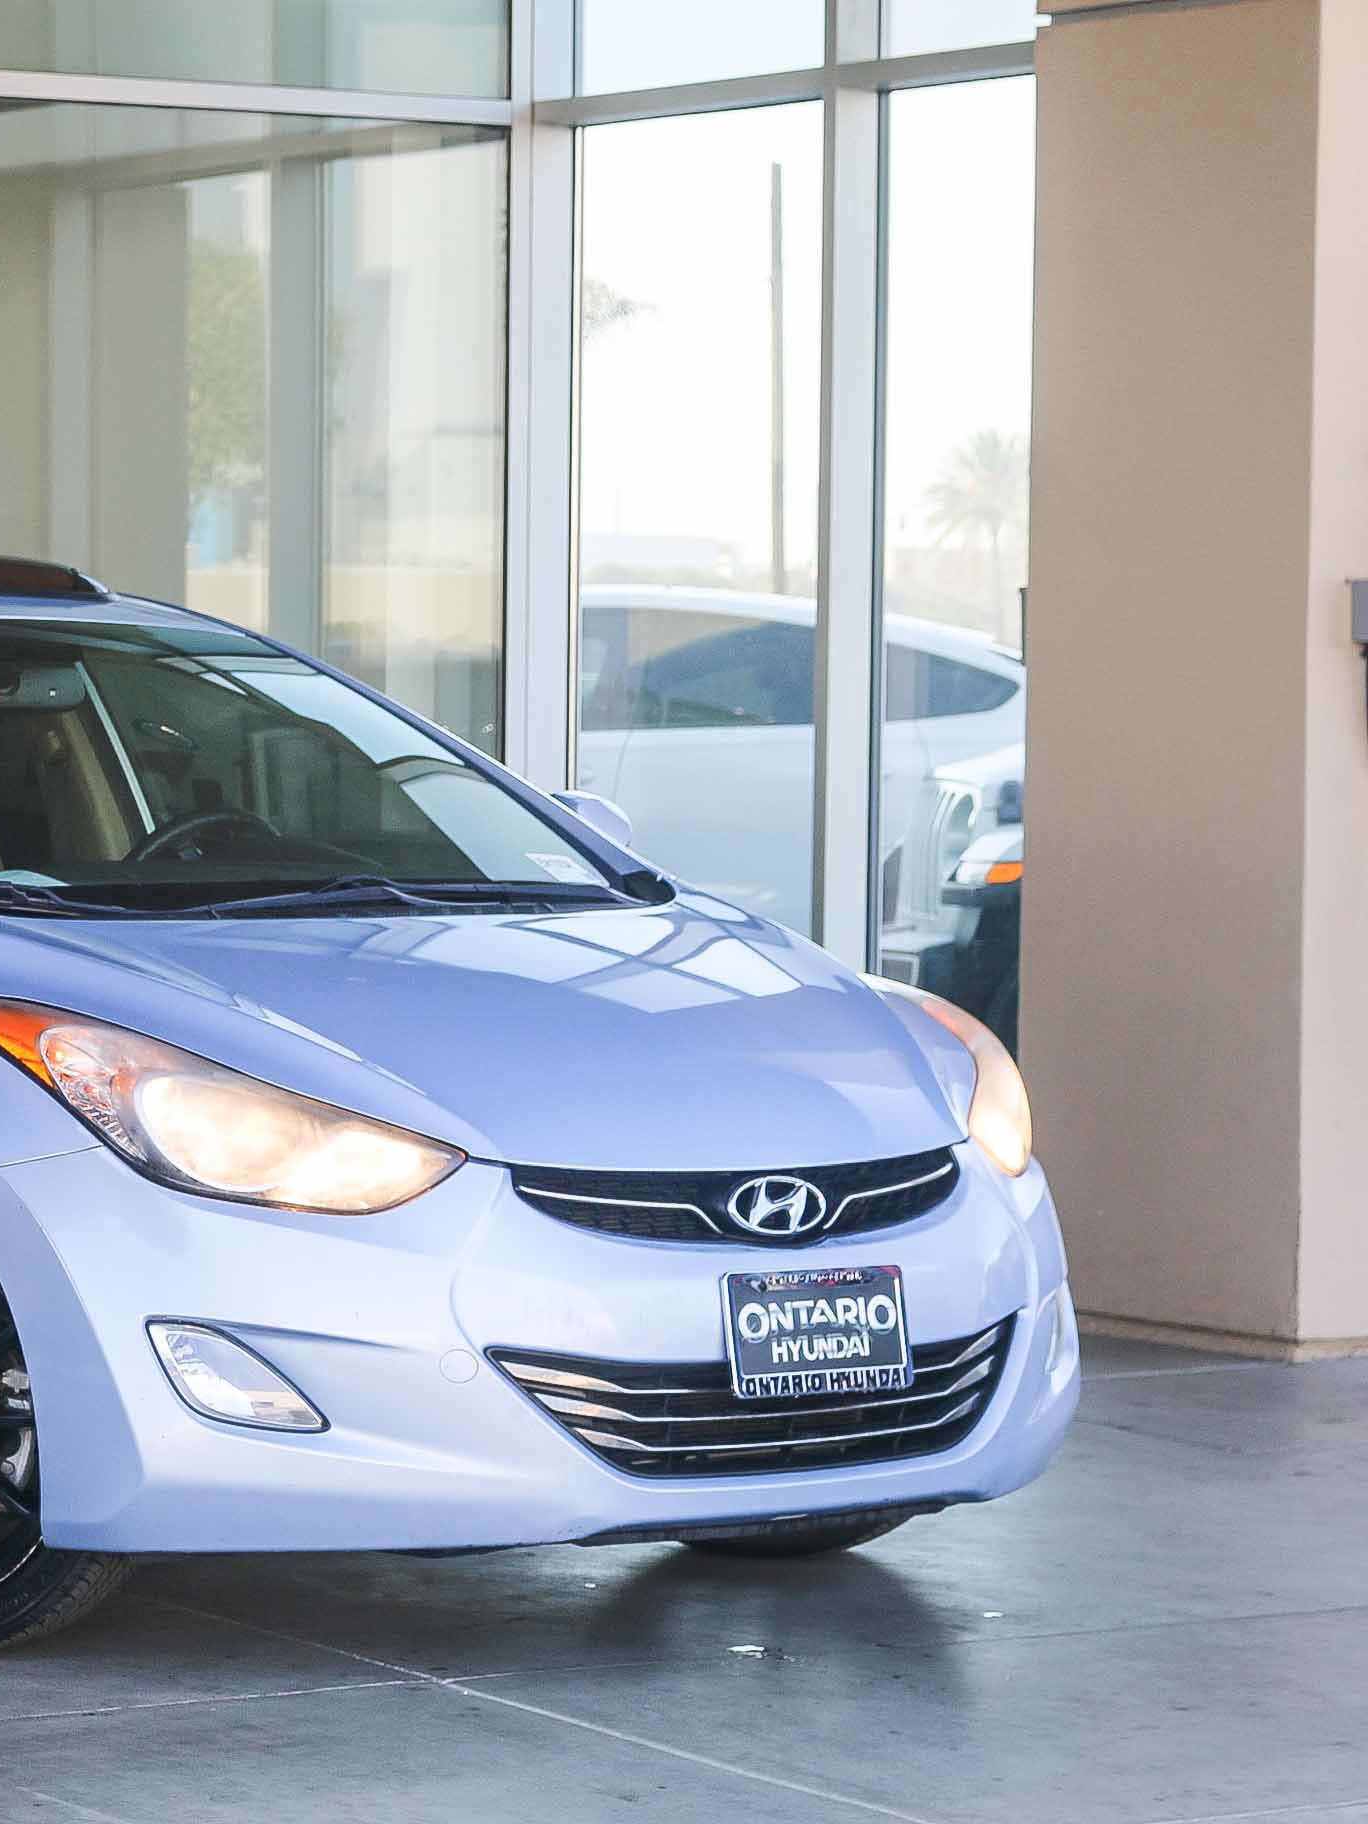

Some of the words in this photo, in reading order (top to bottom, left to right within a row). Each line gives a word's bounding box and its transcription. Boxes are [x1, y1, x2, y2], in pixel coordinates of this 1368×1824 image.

[738, 1294, 897, 1341] ONTARIO
[771, 1332, 871, 1364] HYUNDAI
[745, 1373, 822, 1396] ONTARIO
[829, 1368, 906, 1388] HYUNDAI
